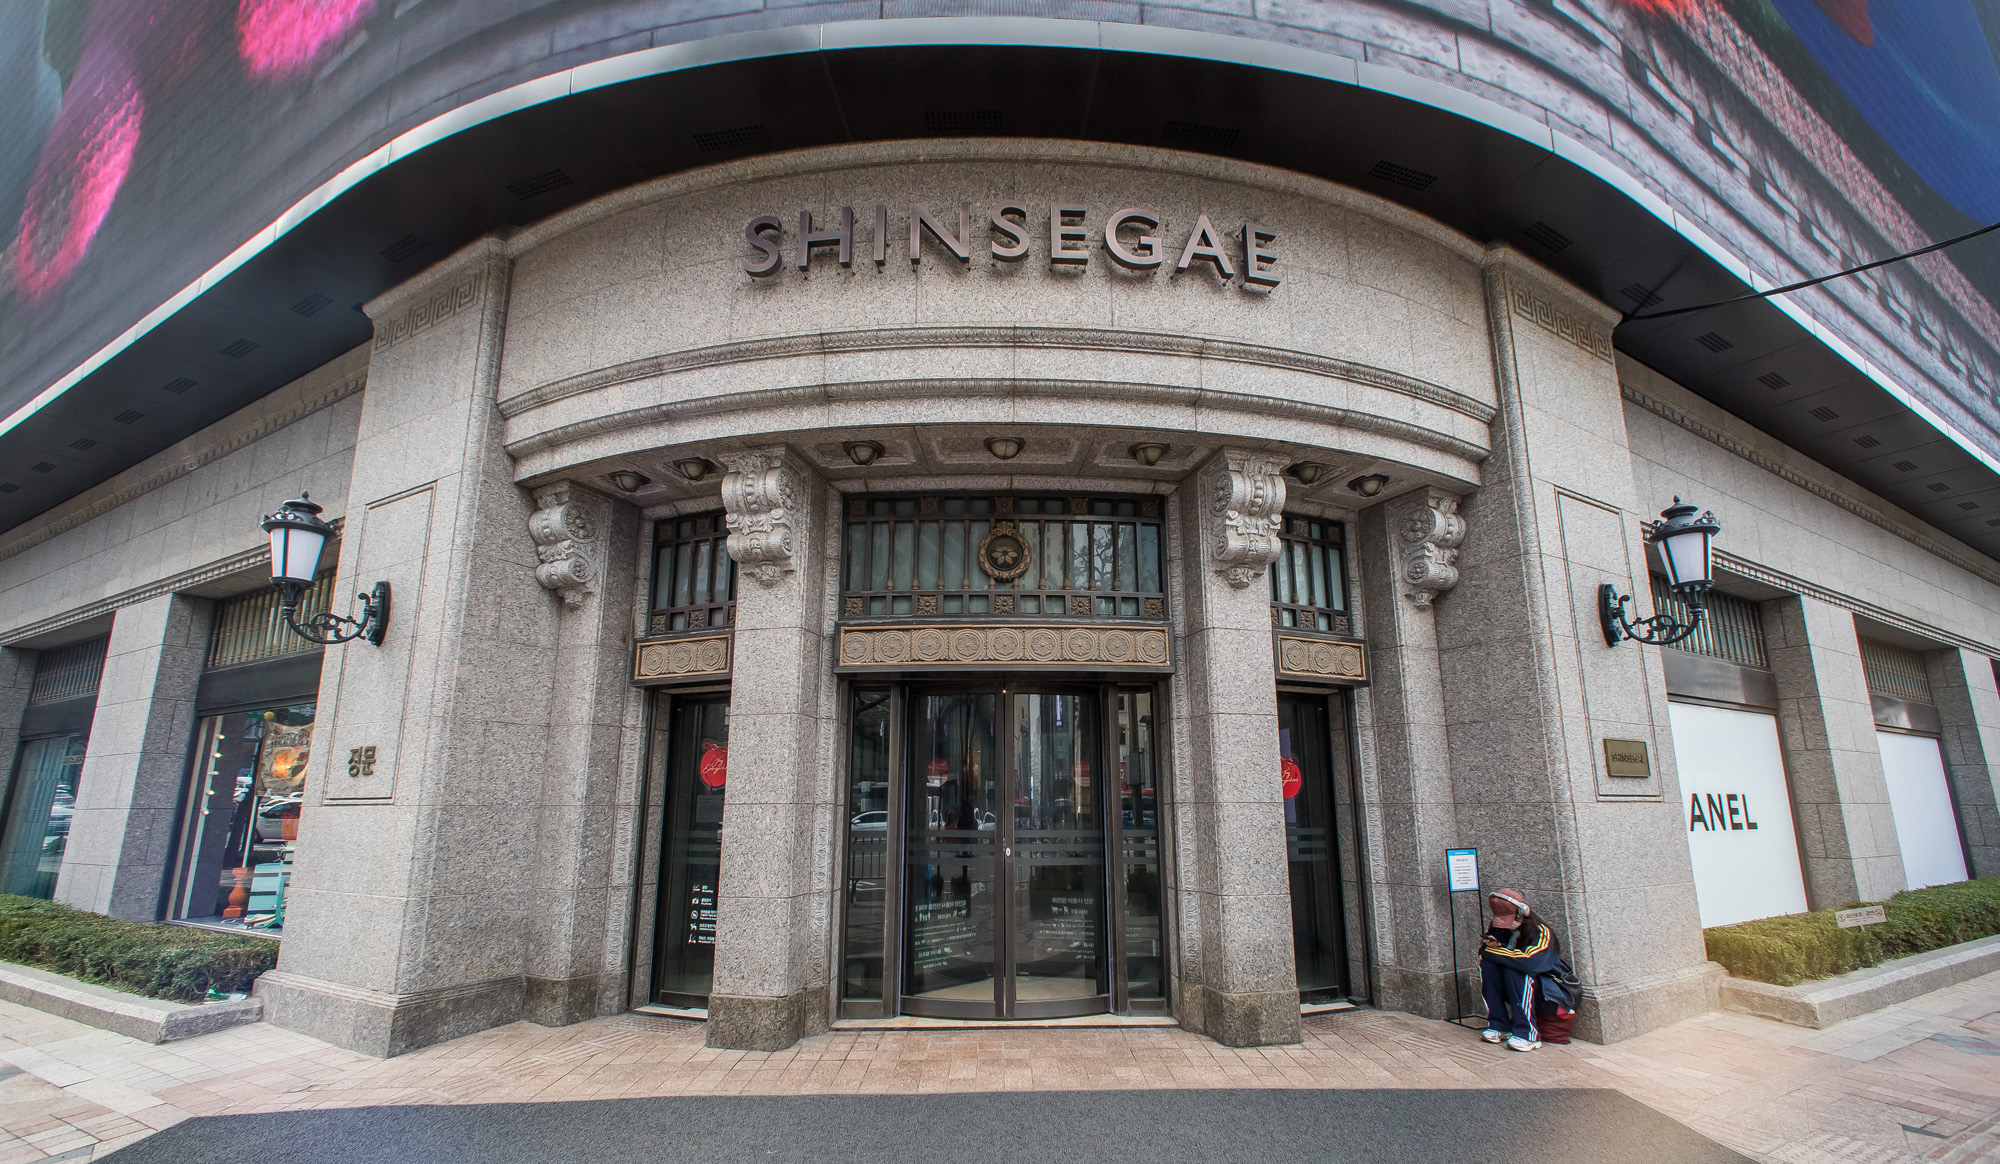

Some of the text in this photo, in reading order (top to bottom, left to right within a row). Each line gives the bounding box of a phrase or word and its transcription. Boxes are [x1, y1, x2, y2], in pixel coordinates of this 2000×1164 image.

[742, 202, 1282, 287] SHINSEGAE
[348, 746, 376, 777] 정문
[1611, 753, 1645, 764] SHINSEGAE
